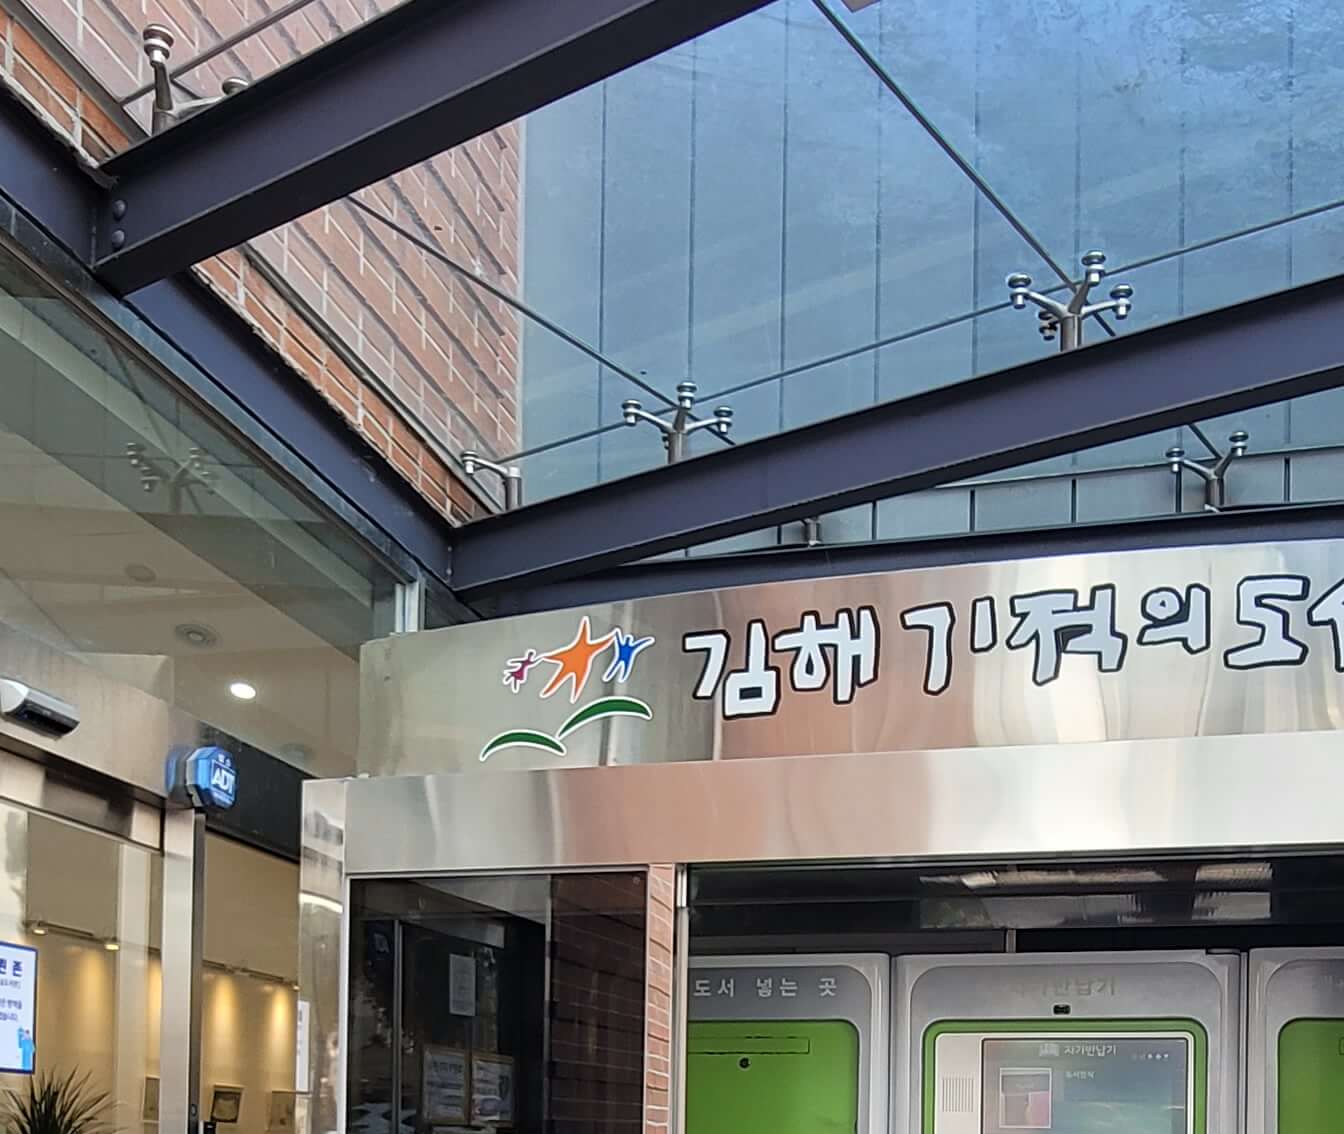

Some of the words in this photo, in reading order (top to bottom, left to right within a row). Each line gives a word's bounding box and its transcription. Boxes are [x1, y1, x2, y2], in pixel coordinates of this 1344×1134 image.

[211, 767, 236, 795] ADT
[693, 977, 736, 998] 도서
[756, 977, 798, 998] 넣는
[818, 977, 838, 997] 곳
